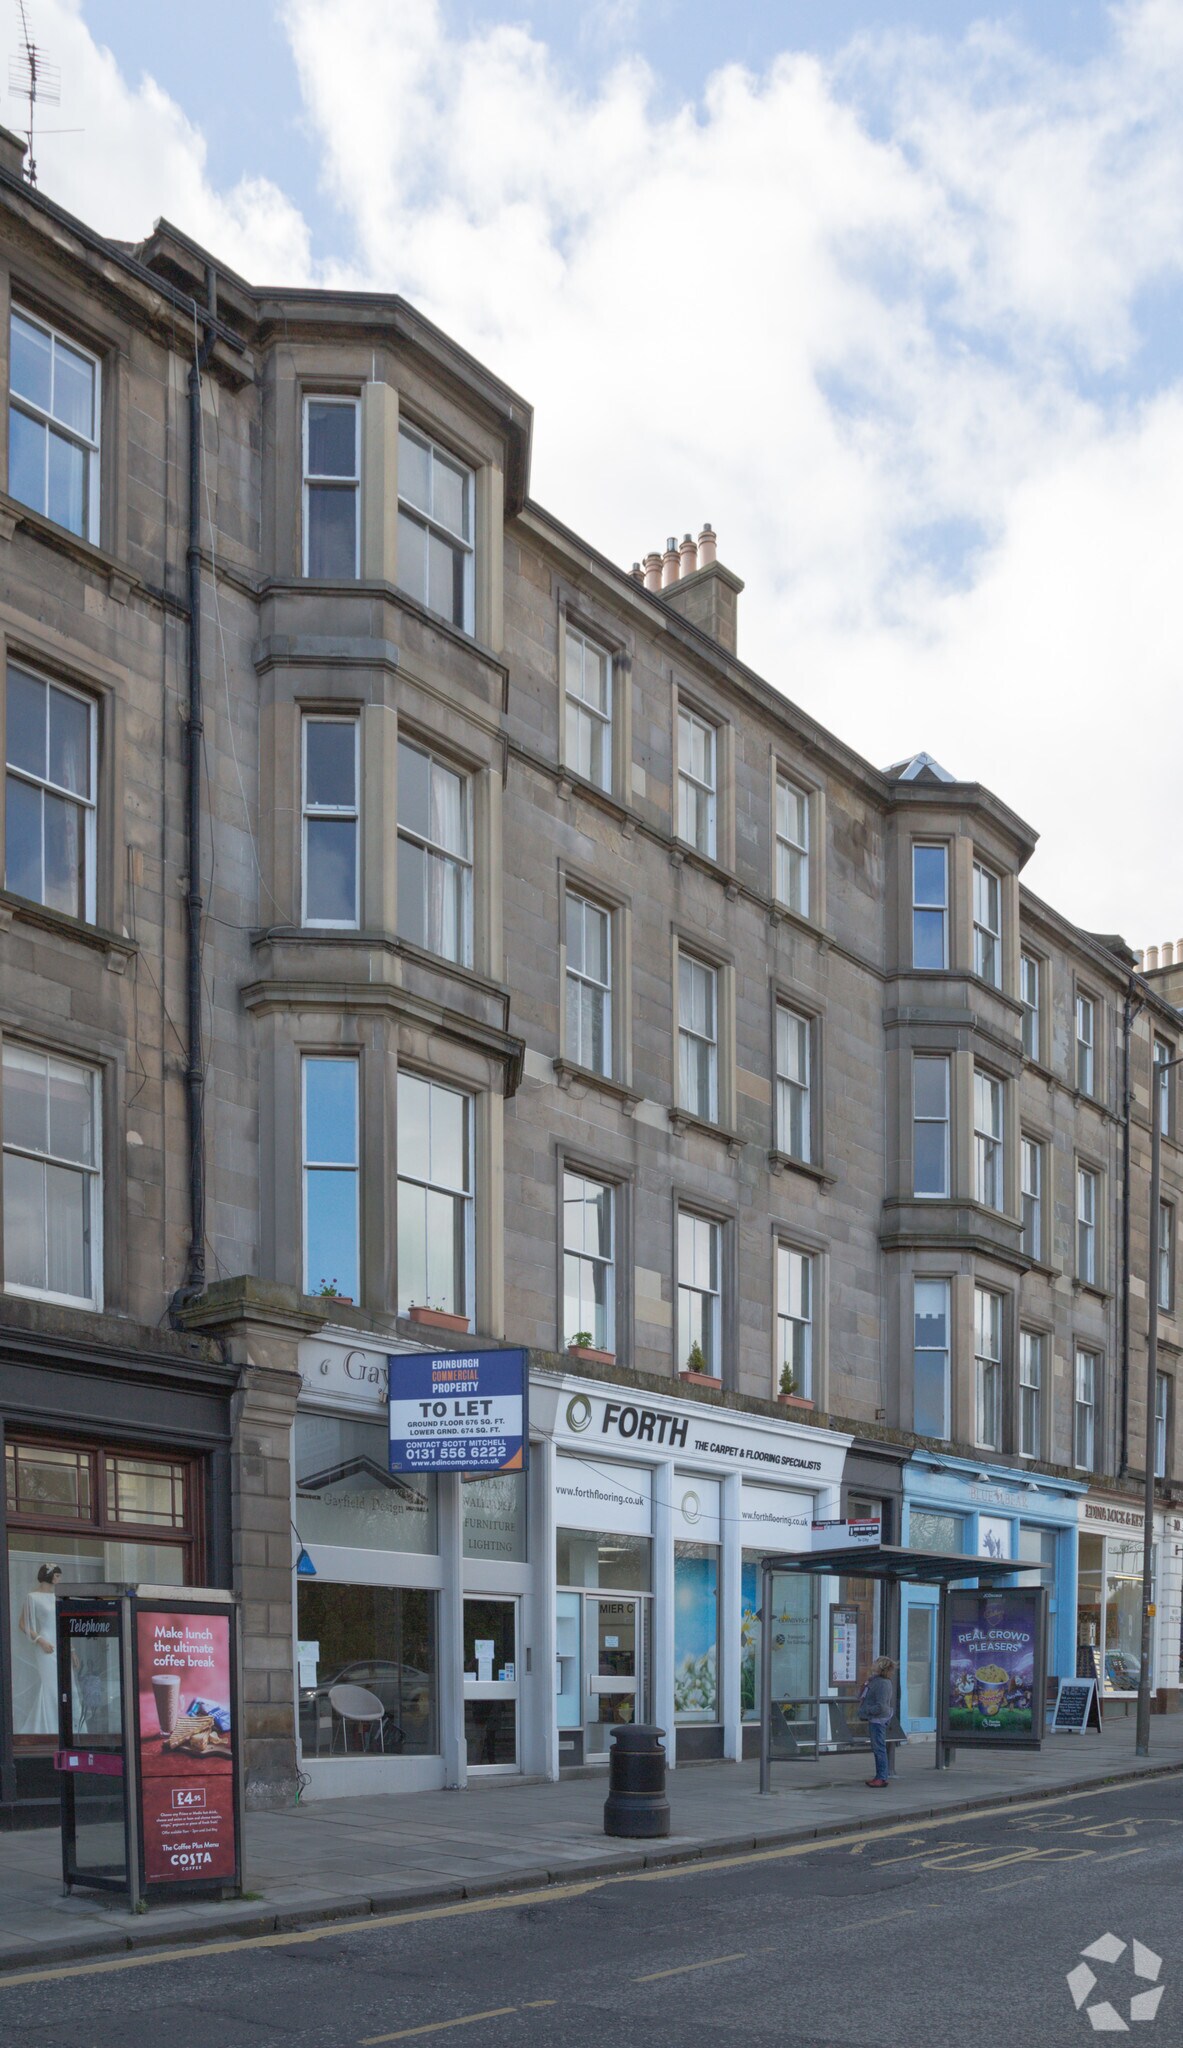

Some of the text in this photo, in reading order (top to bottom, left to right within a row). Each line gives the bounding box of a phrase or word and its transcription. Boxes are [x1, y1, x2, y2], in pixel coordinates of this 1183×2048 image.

[432, 1359, 479, 1370] EDINBURGH
[432, 1370, 479, 1382] COMMERCIAL
[432, 1382, 479, 1393] PROPERTY
[419, 1400, 493, 1418] TO LET
[602, 1403, 689, 1448] FORTH
[406, 1441, 440, 1449] CONTACT
[442, 1440, 467, 1448] SCOTT
[406, 1446, 507, 1460] 0131 556 6222
[694, 1440, 822, 1471] THE CARPET & FLOORING SPECIALISTS
[411, 1458, 500, 1467] www.edincomprop.co.uk
[323, 1492, 404, 1516] Gayfield Design
[970, 1487, 1029, 1508] BLUE BEAR
[464, 1518, 516, 1532] FURNITURE
[1107, 1508, 1126, 1525] LOCK
[1131, 1513, 1145, 1528] KEY
[468, 1539, 513, 1552] LIGHTING
[600, 1604, 624, 1614] MIER
[69, 1618, 111, 1635] Telephone
[154, 1626, 213, 1640] Make lunch
[958, 1630, 1030, 1643] REAL CROWD
[154, 1640, 214, 1654] the ultimate
[969, 1643, 1018, 1652] PLEASERS
[153, 1654, 215, 1668] coffee break
[173, 1843, 191, 1851] Coffee
[170, 1852, 212, 1866] COSTA
